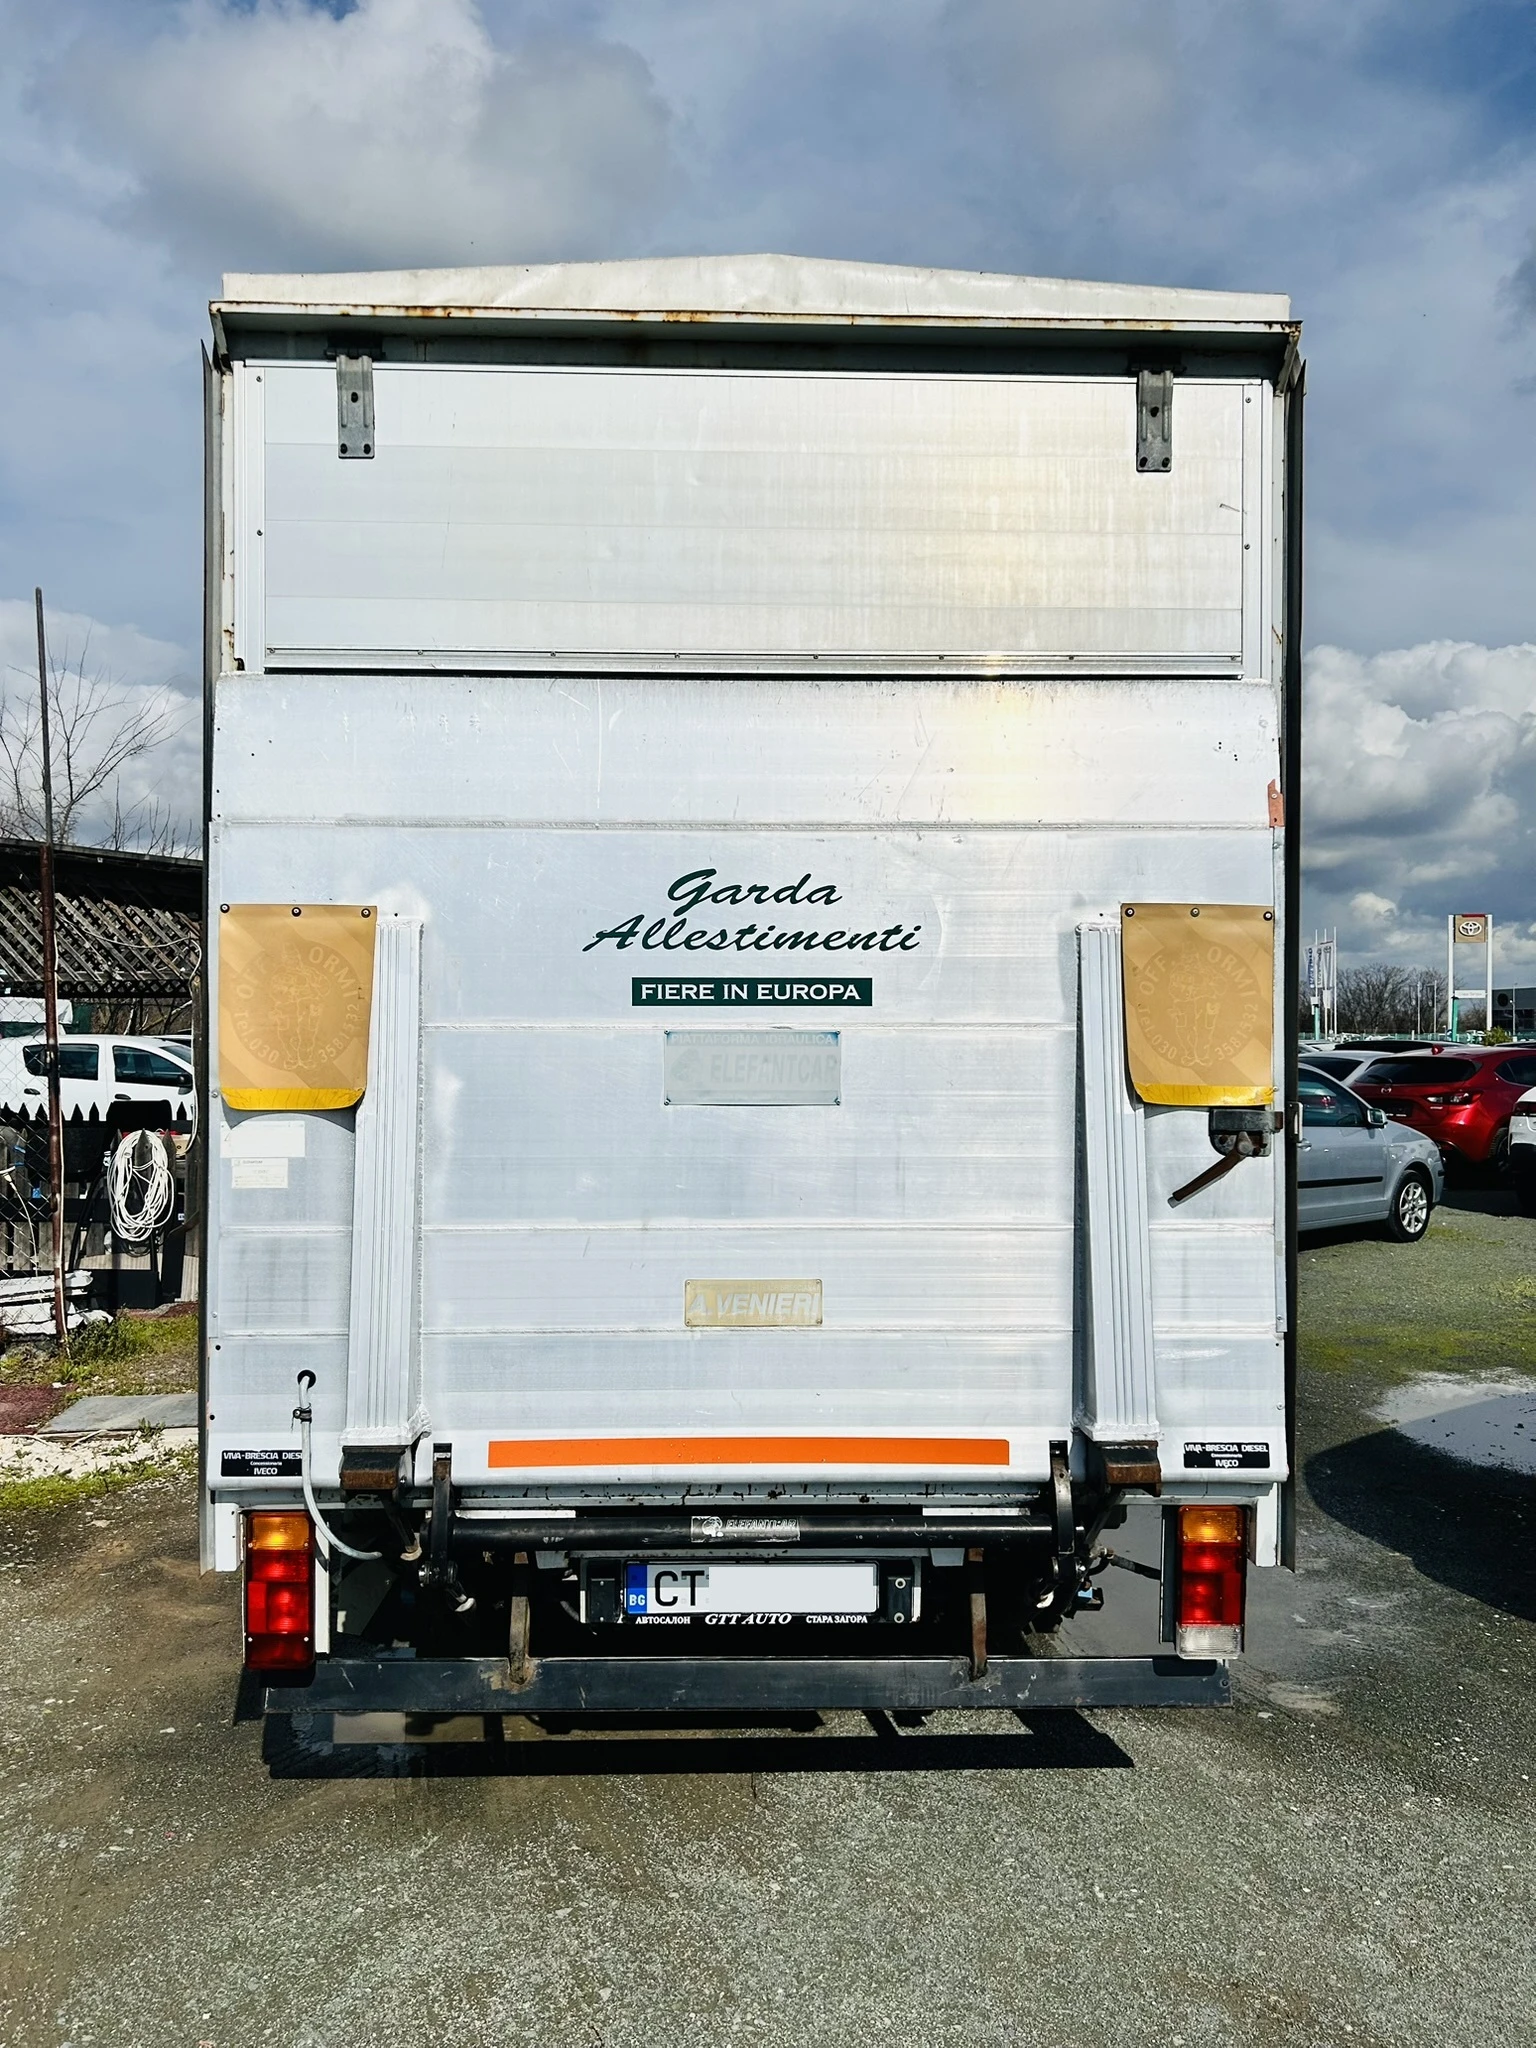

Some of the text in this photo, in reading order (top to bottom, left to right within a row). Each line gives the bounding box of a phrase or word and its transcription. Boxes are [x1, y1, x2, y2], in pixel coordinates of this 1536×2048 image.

[667, 868, 843, 917] Garda
[582, 914, 922, 952] Allestimenti
[308, 946, 359, 998] ORMI
[1206, 946, 1257, 997] ORMI
[640, 983, 861, 1000] FIERE IN EUROPA
[670, 1033, 834, 1045] PIATTAFORMA IDRAULICA
[709, 1053, 838, 1084] ELEFANTCAR
[1241, 1444, 1268, 1452] DIESEL
[253, 1467, 278, 1475] IVECO
[629, 1570, 706, 1607] BG CT
[635, 1615, 691, 1625] АВТОСАЛОН
[704, 1613, 792, 1625] GTT AUTO
[805, 1615, 868, 1624] СТАРА ЗАГОРА
